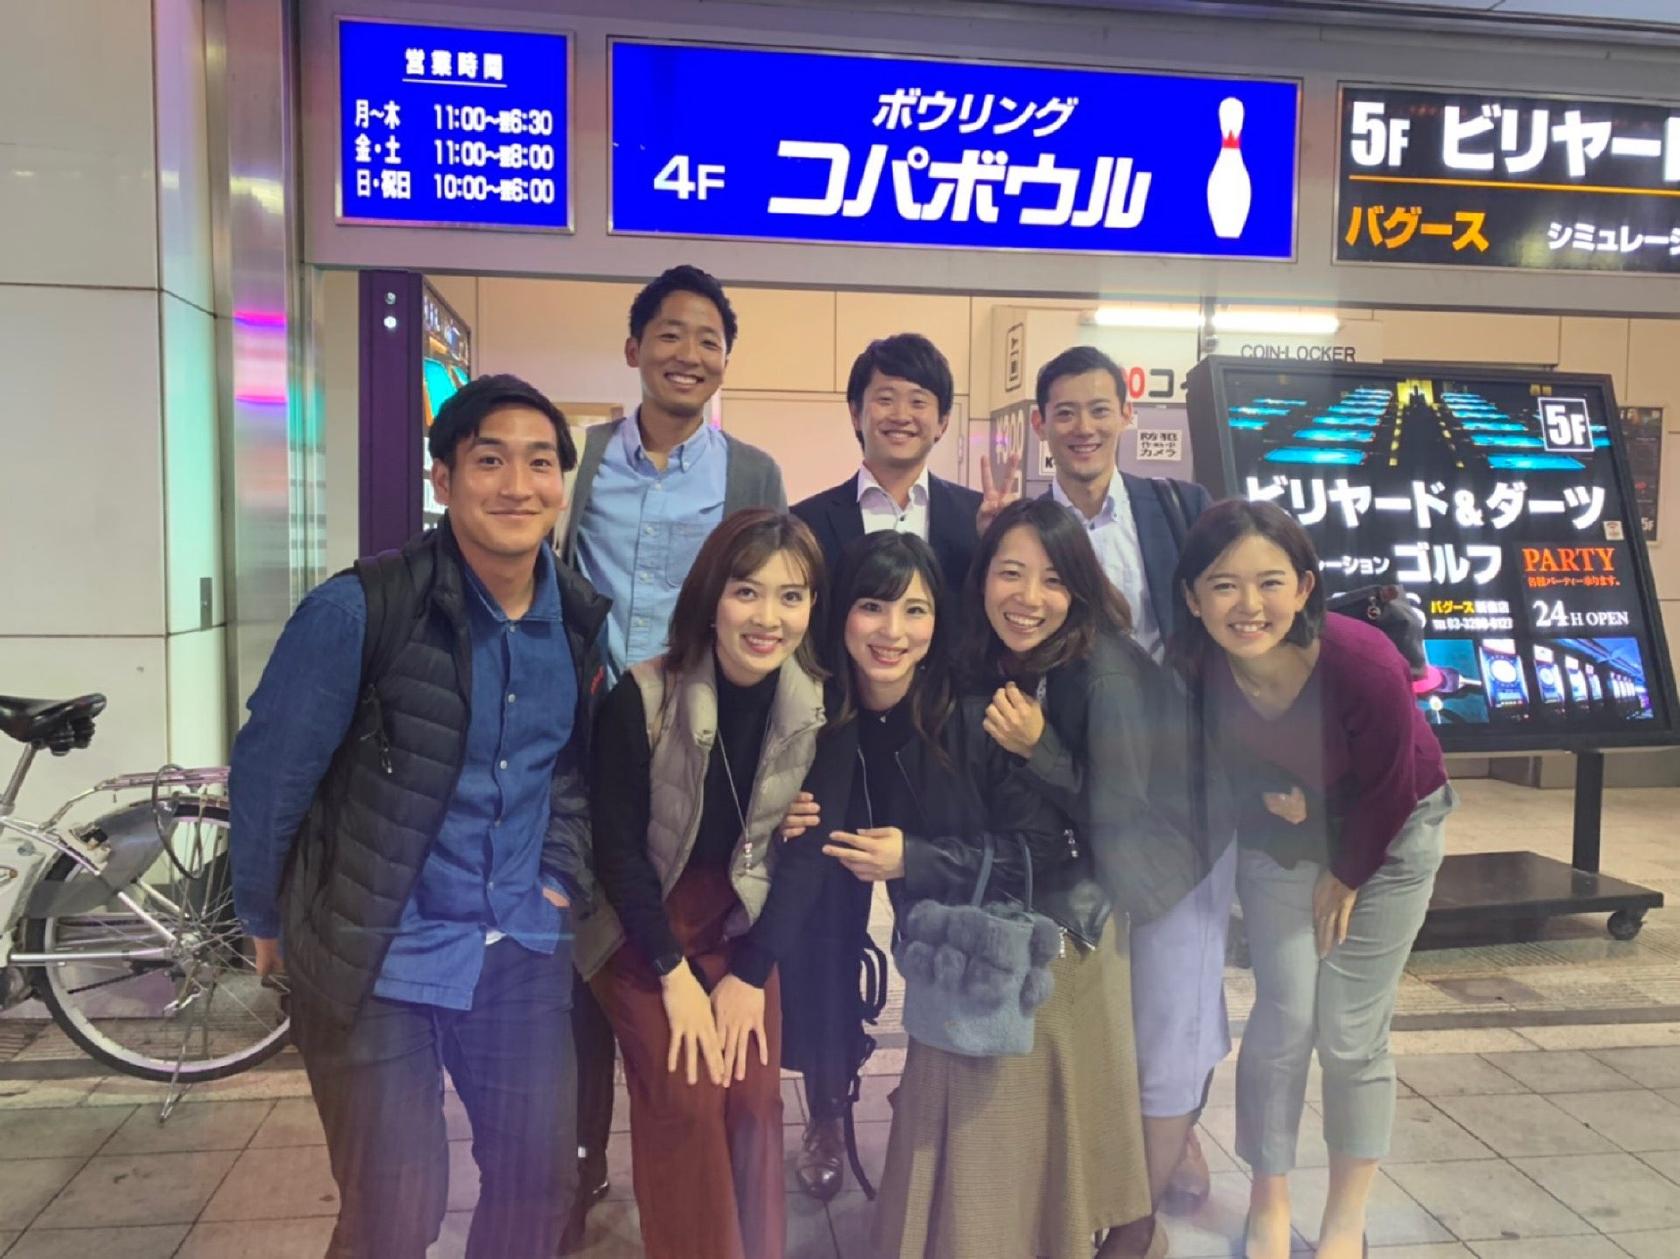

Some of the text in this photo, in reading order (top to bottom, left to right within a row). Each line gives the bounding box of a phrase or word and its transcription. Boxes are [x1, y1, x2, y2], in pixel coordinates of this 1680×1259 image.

[405, 47, 503, 81] 営業時間
[355, 99, 401, 130] 月～木
[872, 87, 1079, 137] ボウリング
[355, 133, 401, 164] 金・土
[1350, 100, 1411, 167] 5F
[356, 168, 411, 200] 日・祝日
[653, 139, 1152, 229] 4F コパボウル
[1345, 204, 1489, 253] バグース
[1545, 404, 1586, 447] 5F
[1140, 448, 1177, 458] カメラ
[1318, 541, 1502, 584] ーション ゴルフ
[1521, 547, 1615, 573] PARTY
[1585, 610, 1630, 626] OPEN
